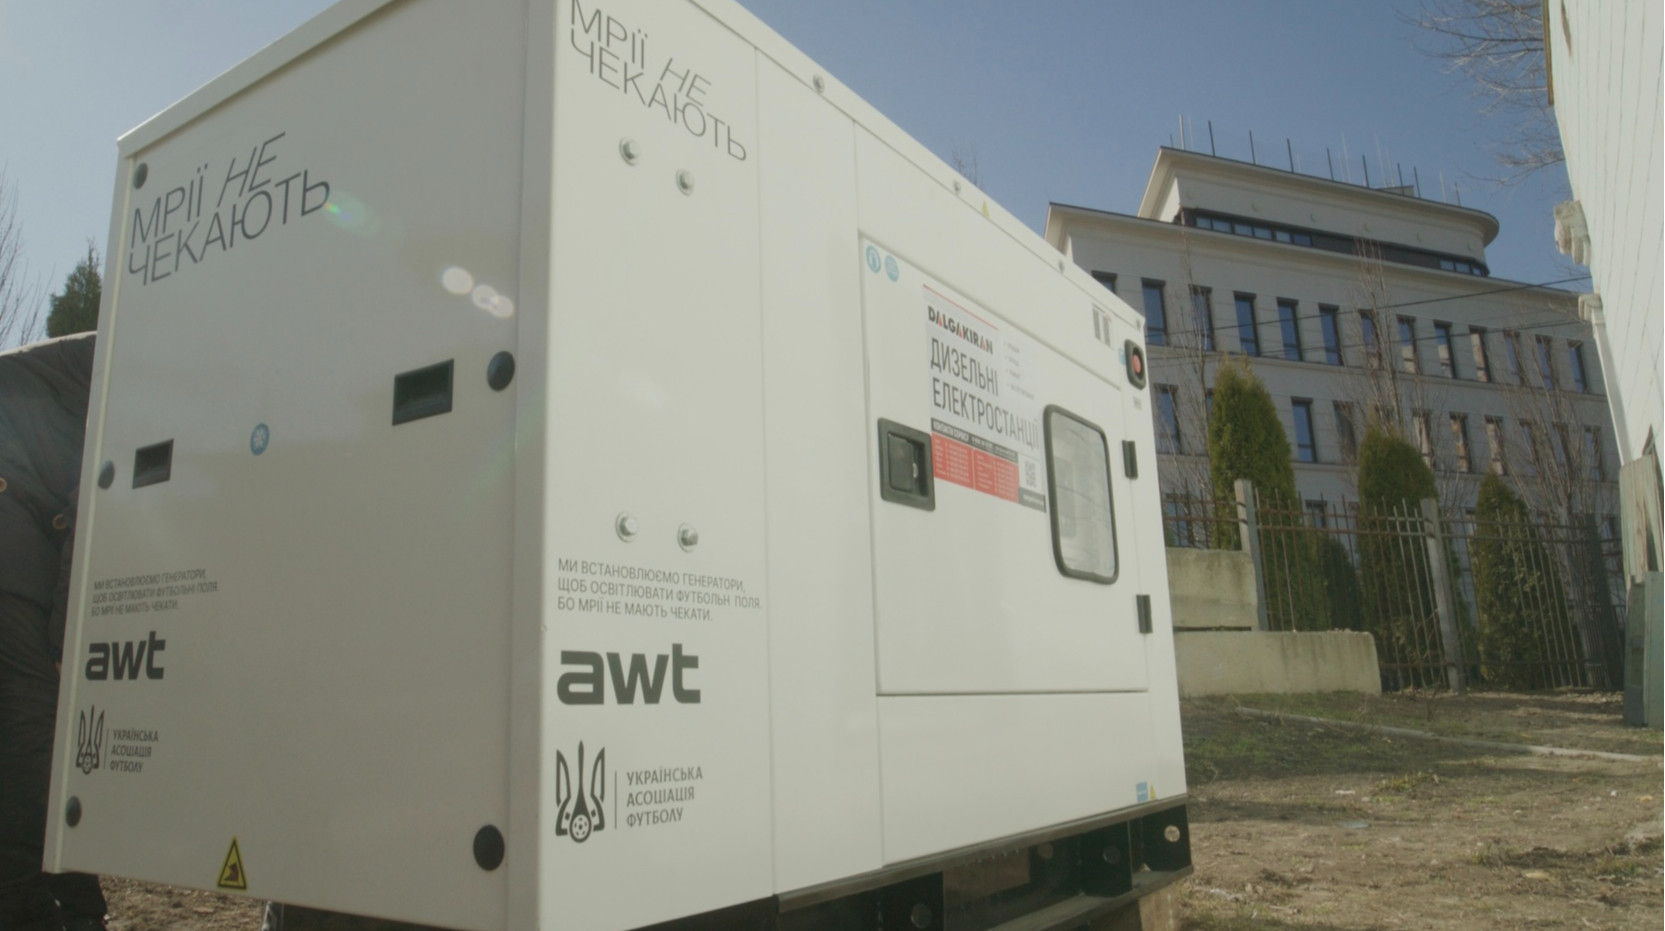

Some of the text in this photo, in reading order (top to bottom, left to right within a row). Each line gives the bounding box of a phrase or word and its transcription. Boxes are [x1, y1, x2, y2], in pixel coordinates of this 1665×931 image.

[571, 0, 712, 107] МРІЇ НЕ
[571, 28, 747, 161] ЧЕКАЮТЬ
[131, 131, 286, 249] МРІЇ НЕ
[128, 169, 330, 286] ЧЕКАЮТЬ
[928, 305, 993, 355] DALGAKIRAN
[930, 337, 998, 397] ДИЗЕЛЬНІ
[932, 377, 1040, 452] ЕЛЕКТРОСТАНЦІЇ
[558, 558, 746, 593] МИ ВСТАНОВЛЮЄМО ГЕНЕРАТОРИ,
[558, 577, 588, 593] ЩОБ
[590, 580, 673, 601] ОСВІТЛЮВАТИ
[557, 596, 714, 622] БО МРІЇ НЕ МАЮТЬ ЧЕКАТИ.
[85, 630, 166, 681] awt
[557, 643, 701, 705] awt
[112, 727, 159, 742] УКРАЇНСЬКА
[110, 760, 144, 773] ФУТБОЛУ
[627, 766, 703, 786] УКРАЇНСЬКА
[627, 786, 695, 807] АСОЦІАЦІЯ
[627, 807, 684, 828] ФУТБОЛУ
